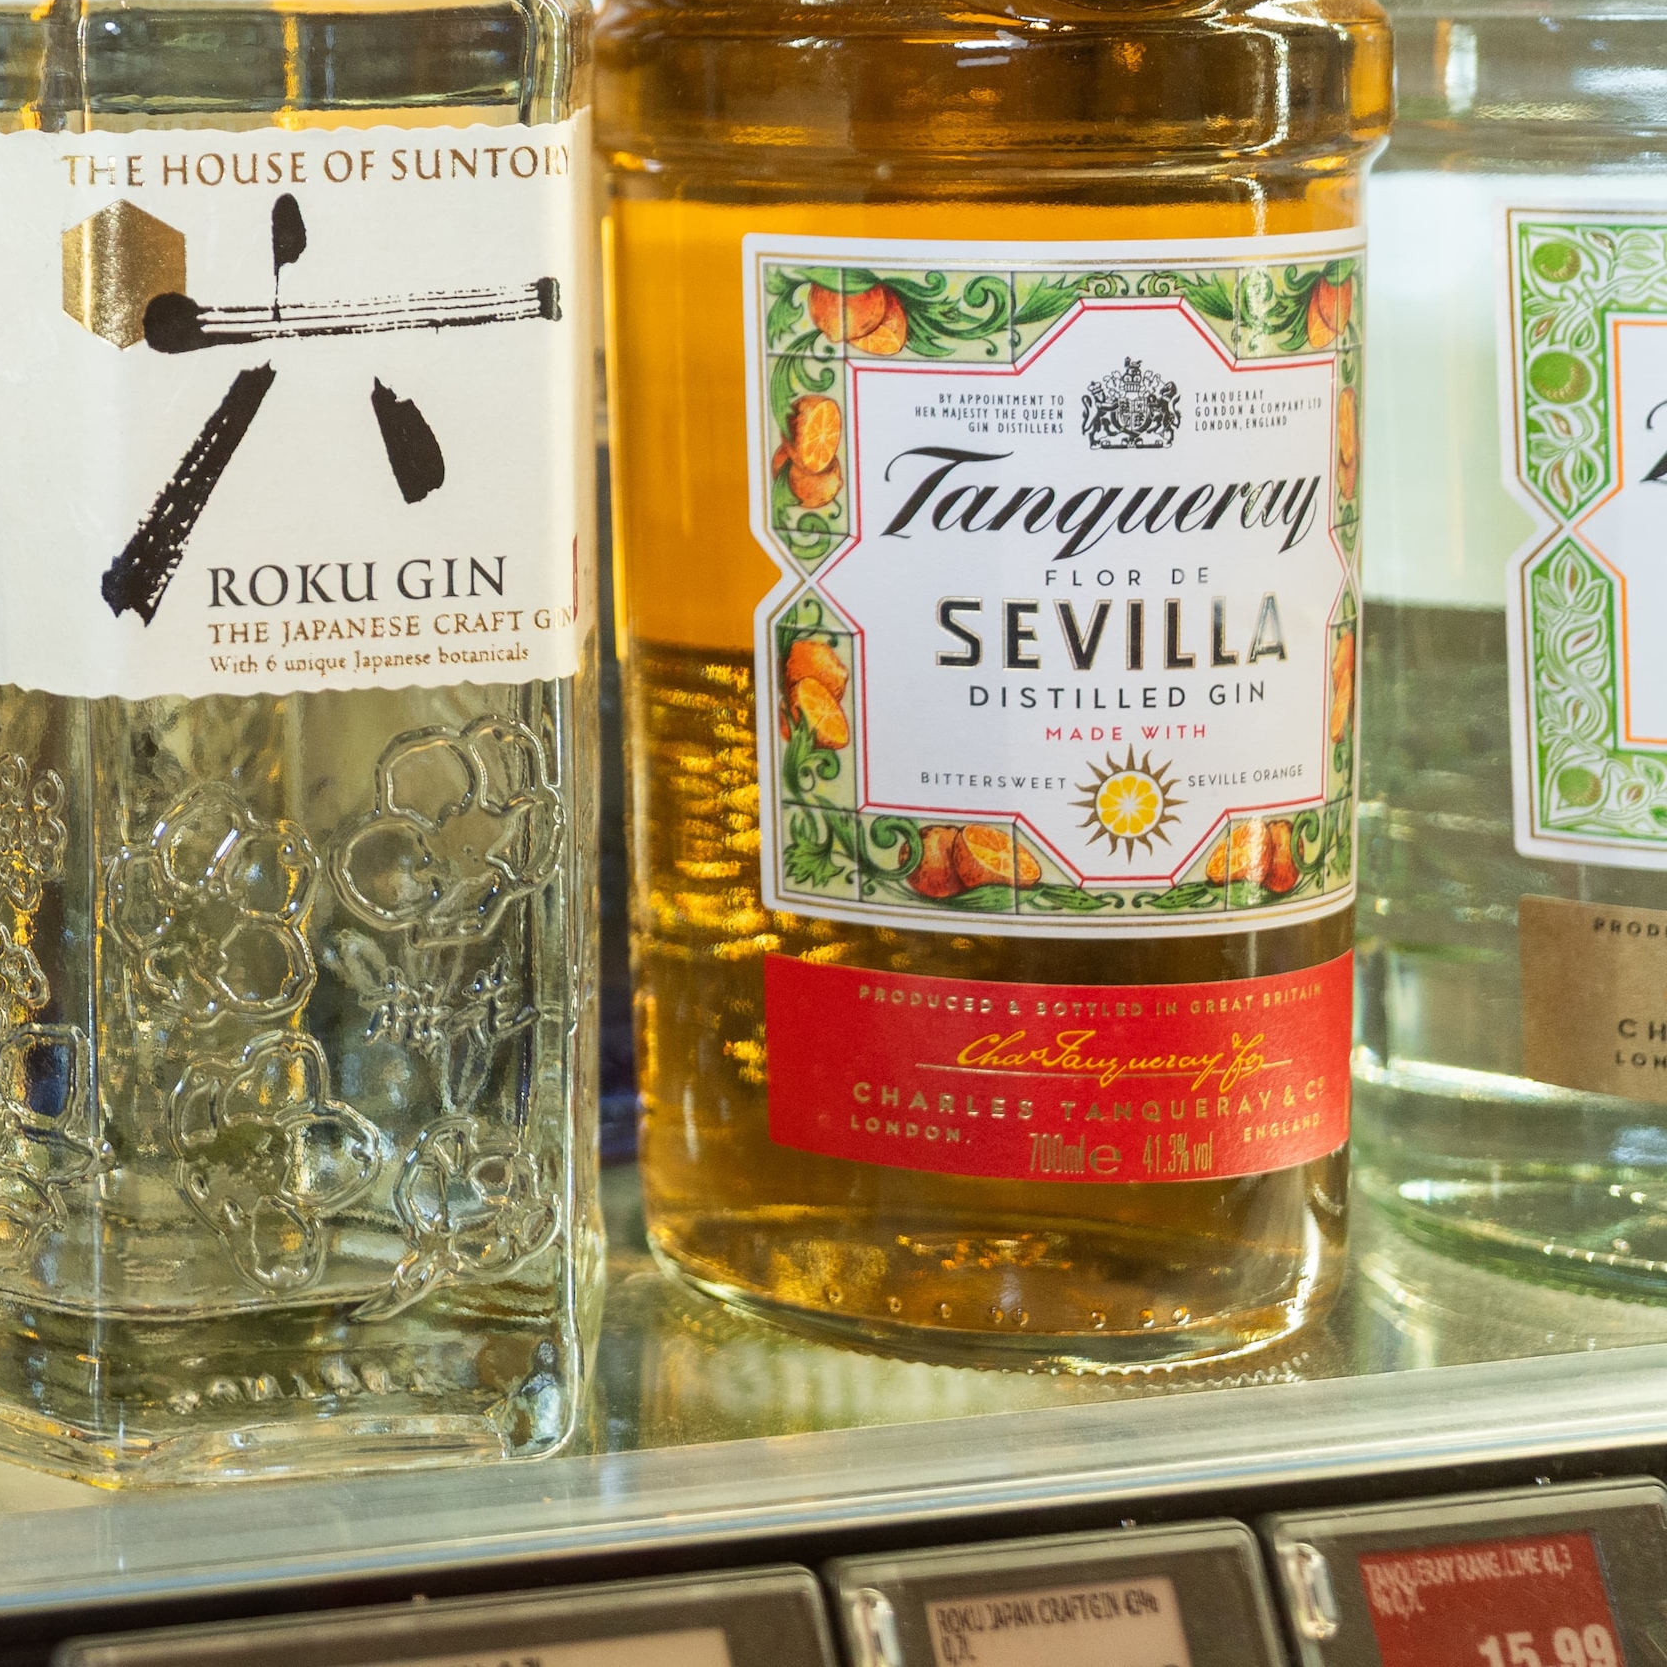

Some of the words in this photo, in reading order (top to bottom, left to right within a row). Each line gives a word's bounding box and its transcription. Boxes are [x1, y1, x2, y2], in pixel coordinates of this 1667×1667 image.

[62, 154, 145, 187] THE
[162, 151, 308, 186] HOUSE
[323, 150, 375, 184] OF
[938, 393, 953, 404] BY
[959, 393, 1044, 406] APPOINTMENT
[1050, 394, 1065, 406] TO
[1195, 389, 1264, 404] TANQUERAY
[1195, 403, 1243, 418] GORDON
[1260, 399, 1305, 415] COMPANY
[915, 406, 937, 418] HER
[942, 407, 989, 421] MAJESTY
[995, 408, 1017, 419] THE
[1022, 409, 1064, 421] QUEEN
[968, 421, 989, 433] GIN
[997, 422, 1064, 434] DISTILLERS
[1245, 415, 1288, 430] ENGLAND
[880, 445, 1322, 562] Tanqueray
[207, 561, 378, 608] ROKU
[397, 555, 508, 601] GIN
[1044, 568, 1142, 588] FLOR
[1171, 566, 1210, 586] DE
[207, 621, 270, 646] THE
[280, 613, 422, 648] JAPANESE
[433, 610, 525, 636] CRAFT
[934, 590, 1290, 673] SEVILLA
[209, 653, 259, 675] With
[266, 653, 278, 673] 6
[284, 653, 348, 678] unique
[354, 649, 432, 674] Japanese
[438, 642, 530, 665] botanicals
[969, 685, 1187, 710] DISTILLED
[1208, 680, 1266, 706] GIN
[1045, 725, 1124, 742] MADE
[1141, 723, 1207, 741] WITH
[920, 770, 1067, 791] BITTERSWEET
[1187, 770, 1248, 789] SEVILLE
[1253, 763, 1305, 784] ORANGE
[1593, 917, 1667, 938] PROD
[859, 984, 993, 1014] PRODUCED
[1008, 1000, 1022, 1016] &
[1036, 1001, 1144, 1018] BOTTLED
[1156, 1001, 1178, 1017] IN
[1189, 993, 1255, 1016] GREAT
[1262, 983, 1322, 1008] BRITAIN
[853, 1081, 1034, 1120] CHARLES
[1060, 1089, 1273, 1123] TANQUERAY
[1281, 1084, 1296, 1109] &
[1028, 1132, 1086, 1175] 700ml
[1142, 1131, 1191, 1175] 41.3%
[1193, 1130, 1215, 1174] vol
[1476, 1623, 1620, 1667] 15.99
